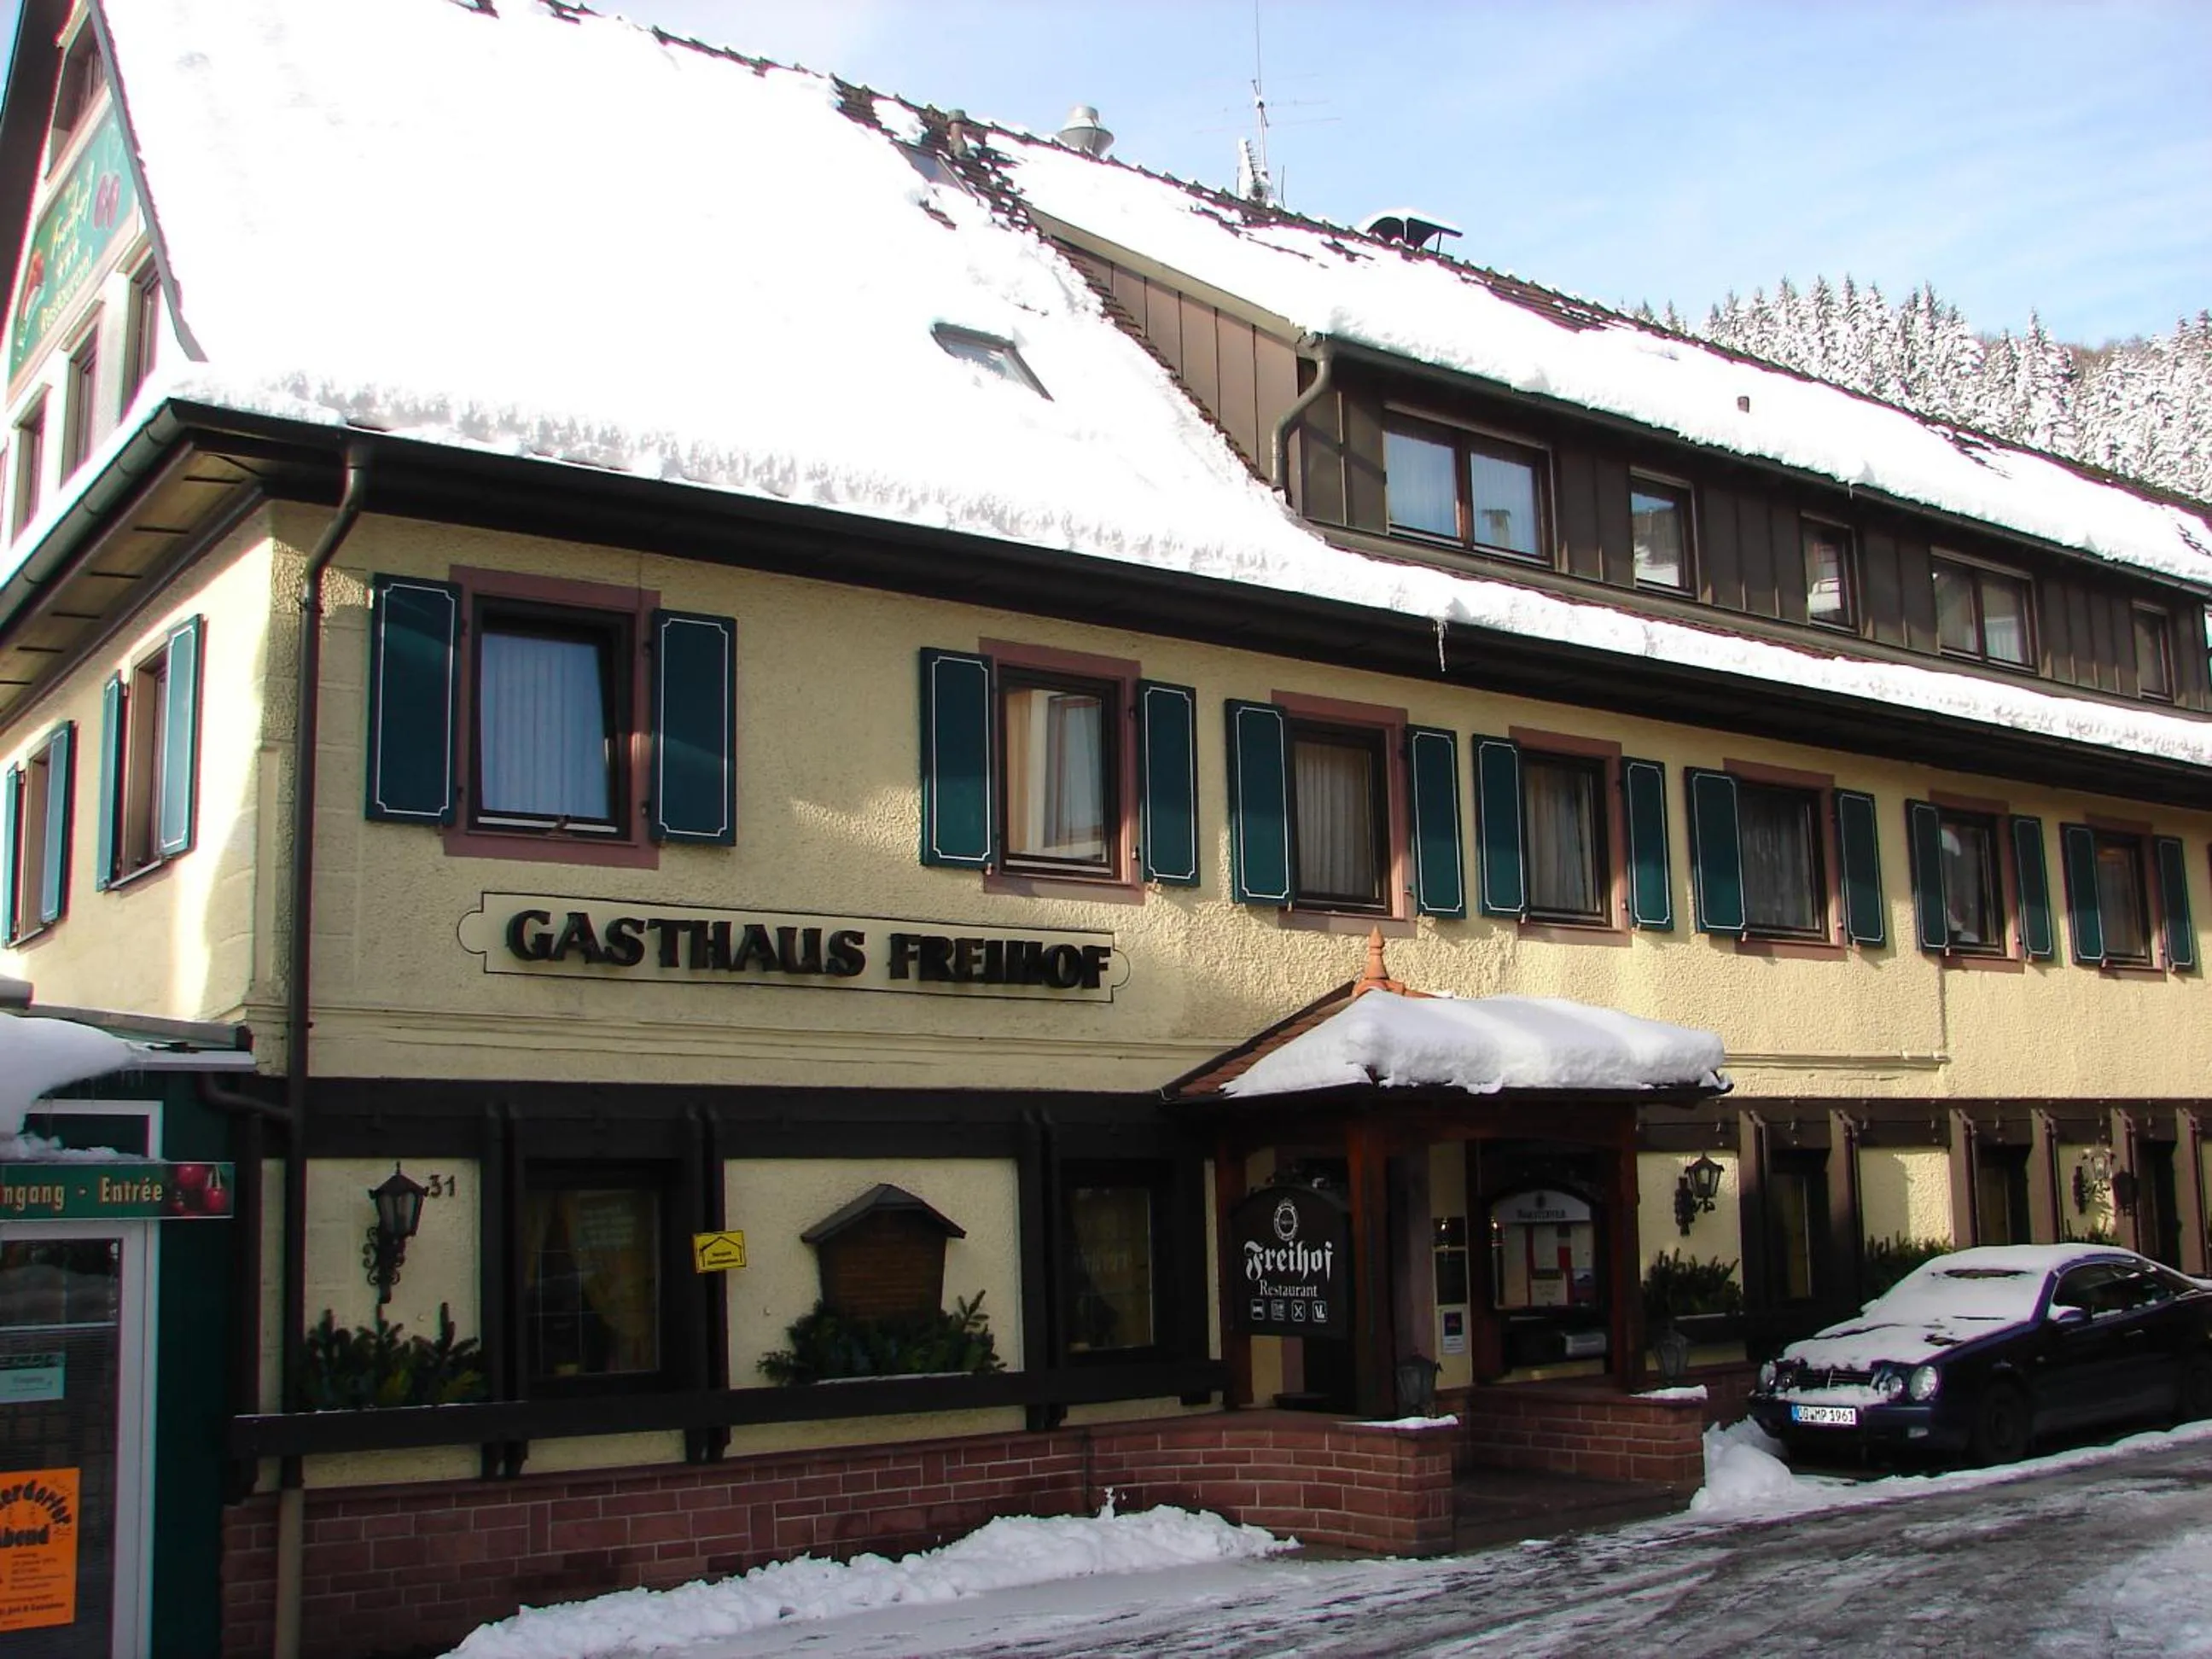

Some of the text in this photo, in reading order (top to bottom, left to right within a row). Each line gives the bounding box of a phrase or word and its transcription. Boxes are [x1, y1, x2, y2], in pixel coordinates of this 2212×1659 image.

[506, 909, 1112, 989] GASTHAUS FREIHOF
[99, 1176, 163, 1202] Entrée
[429, 1174, 455, 1198] 31
[1243, 1240, 1334, 1282] Freihof
[1260, 1280, 1318, 1298] Restaurant
[1829, 1410, 1854, 1423] 1961
